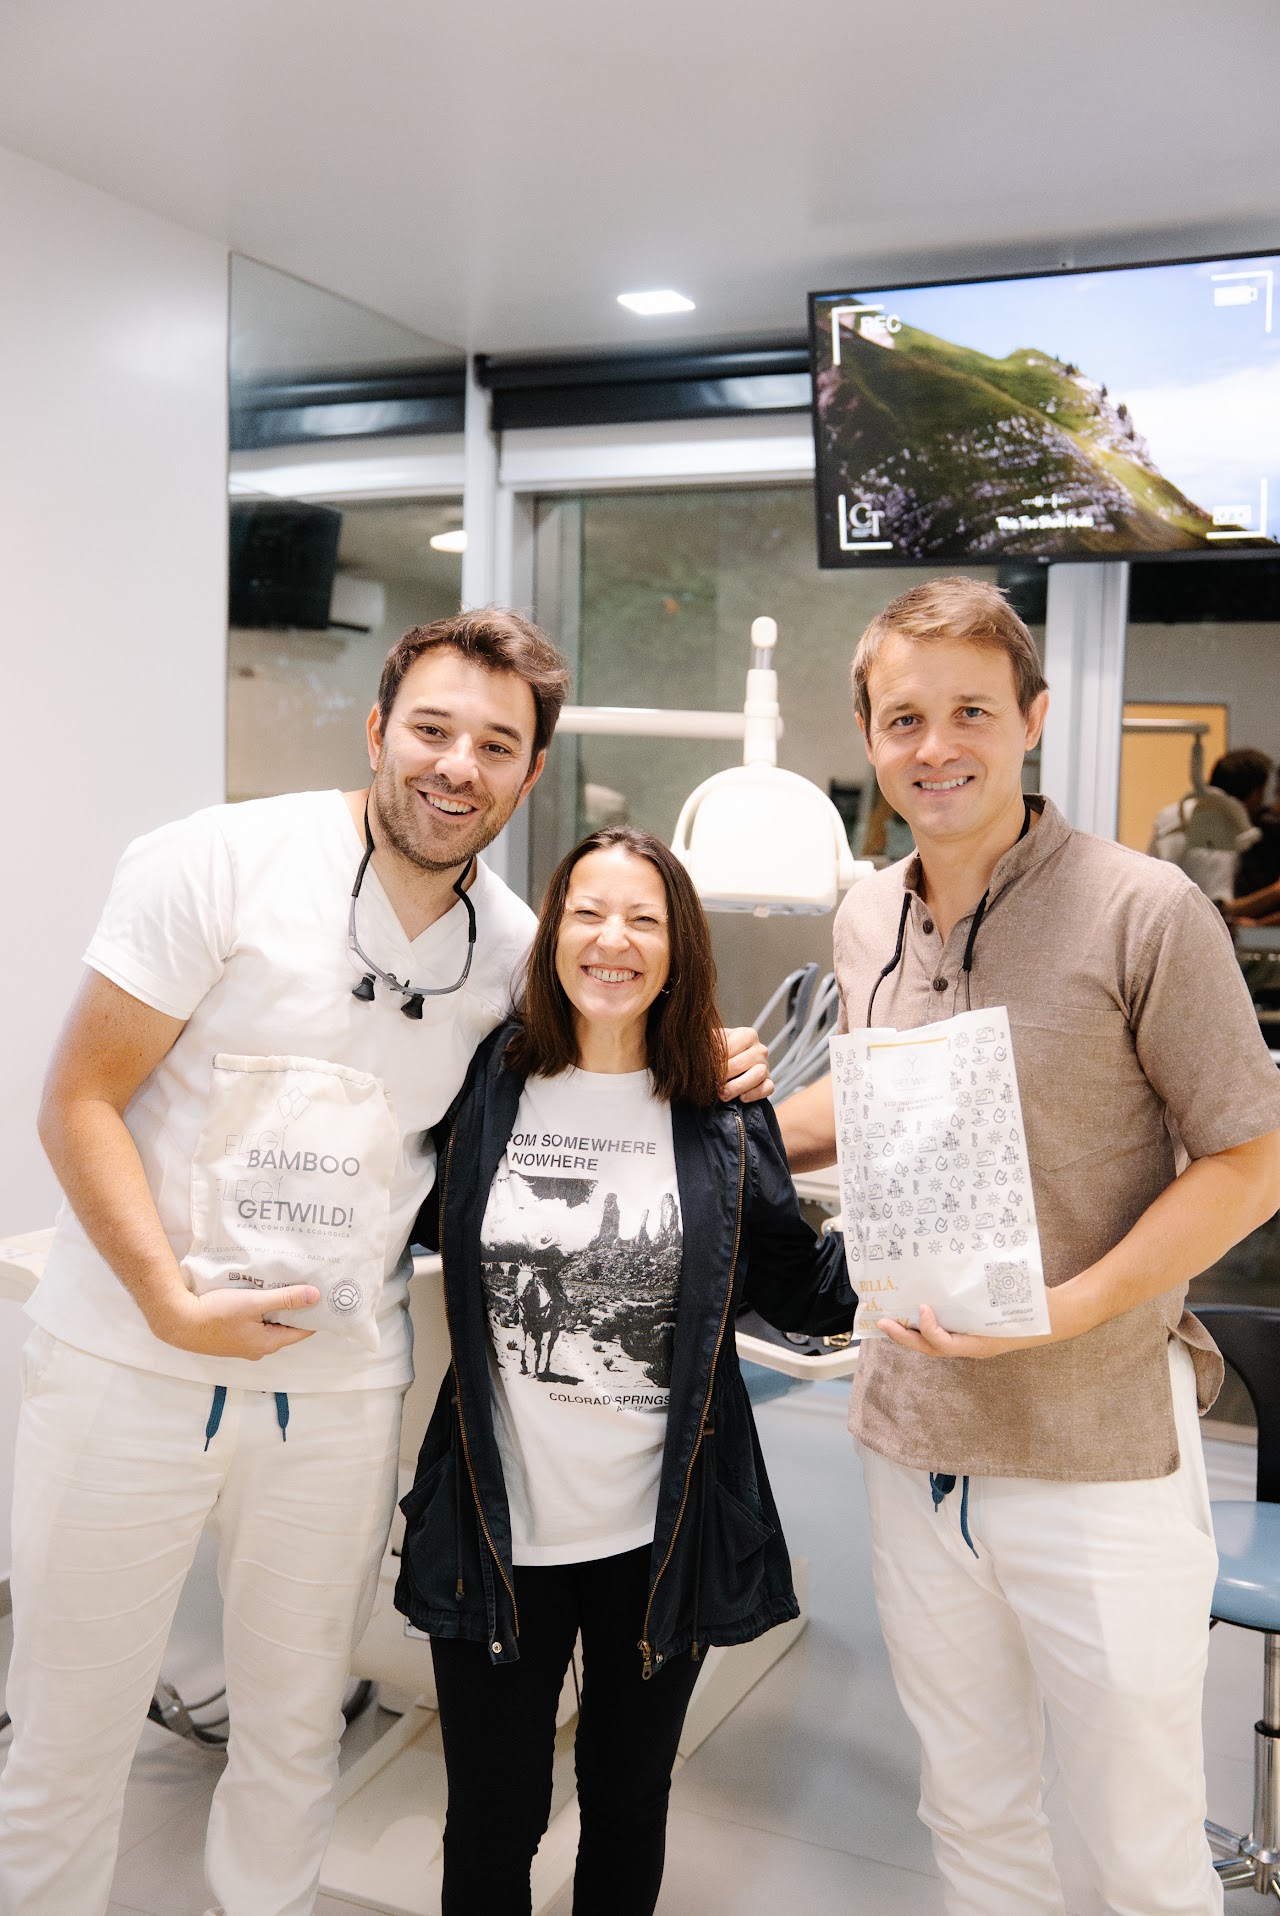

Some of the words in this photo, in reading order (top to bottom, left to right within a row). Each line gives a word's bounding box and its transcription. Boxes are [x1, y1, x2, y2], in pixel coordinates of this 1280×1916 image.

[860, 314, 902, 334] REC
[509, 1133, 537, 1147] OM
[541, 1134, 657, 1155] SOMEWHERE
[247, 1149, 361, 1177] BAMBOO
[511, 1152, 599, 1171] NOWHERE
[237, 1198, 355, 1229] GETWILD!
[615, 1395, 670, 1406] SPRINGS
